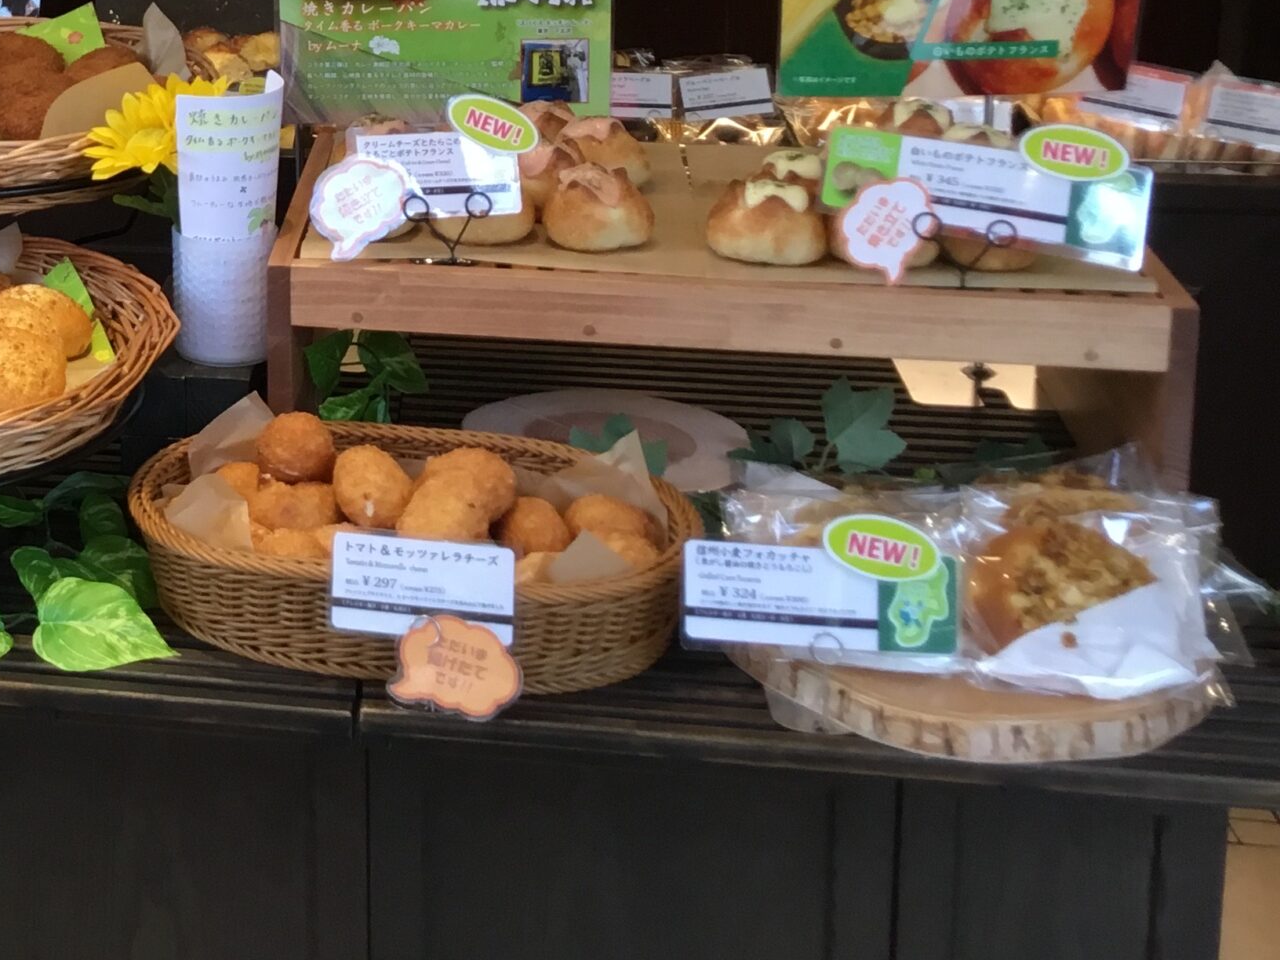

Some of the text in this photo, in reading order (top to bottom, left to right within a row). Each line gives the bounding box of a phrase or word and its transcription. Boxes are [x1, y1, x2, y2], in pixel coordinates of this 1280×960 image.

[302, 1, 433, 17] 焼きカレーパン
[368, 20, 481, 32] ポークキーマカレー
[308, 40, 363, 52] by ムーナ
[465, 108, 524, 145] NEW!
[1042, 140, 1109, 169] NEW!
[848, 532, 920, 569] NEW!
[361, 574, 397, 590] ¥297
[719, 585, 758, 600] ¥324
